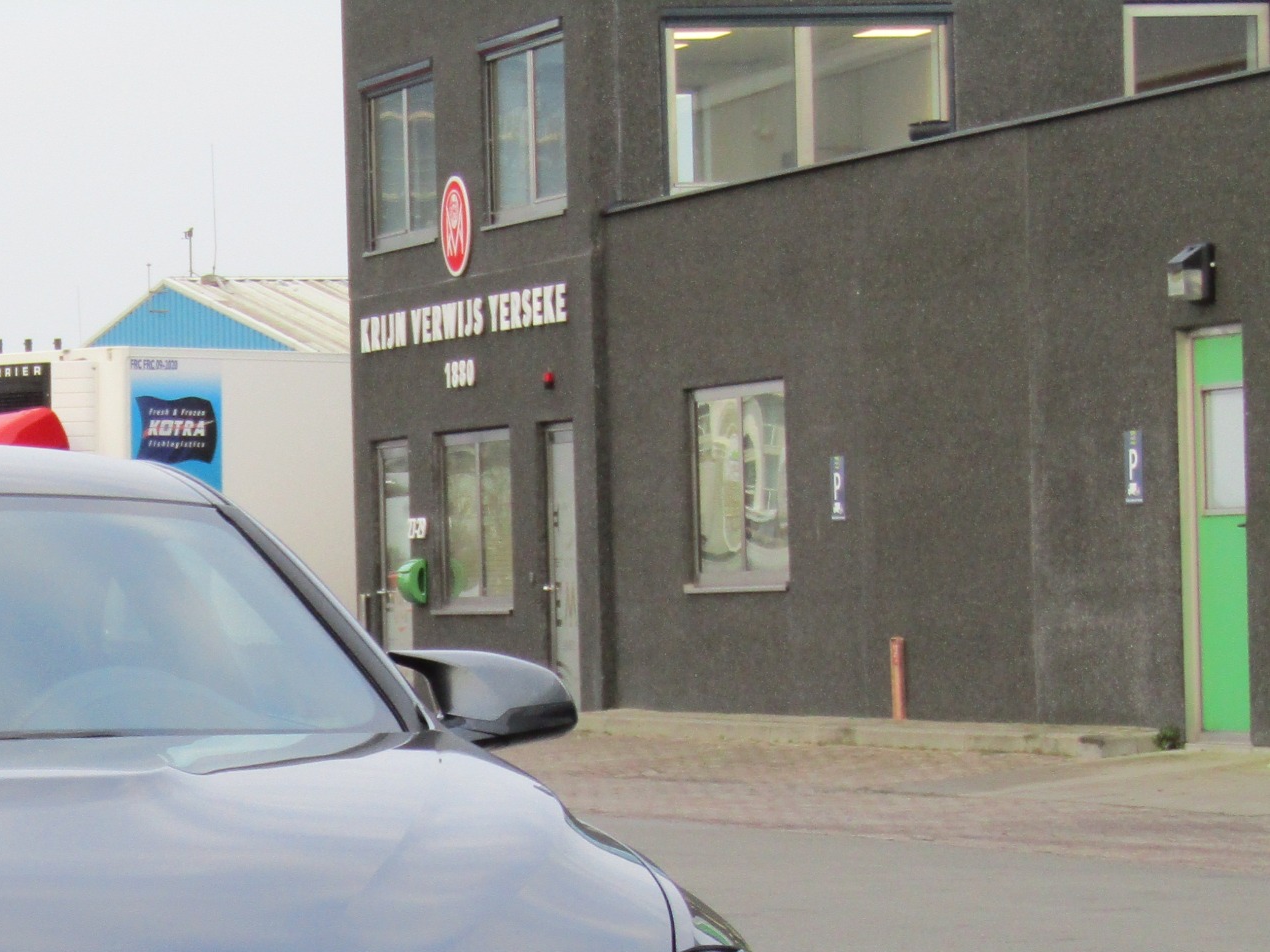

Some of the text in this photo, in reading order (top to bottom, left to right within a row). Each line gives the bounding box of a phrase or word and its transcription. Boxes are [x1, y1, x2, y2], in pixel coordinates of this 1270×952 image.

[360, 283, 567, 353] KRIJN VERWIJS YERSEKE
[444, 359, 475, 388] 1880
[148, 408, 169, 416] Fresh
[181, 408, 206, 416] Frozen
[147, 419, 206, 437] KOTRA
